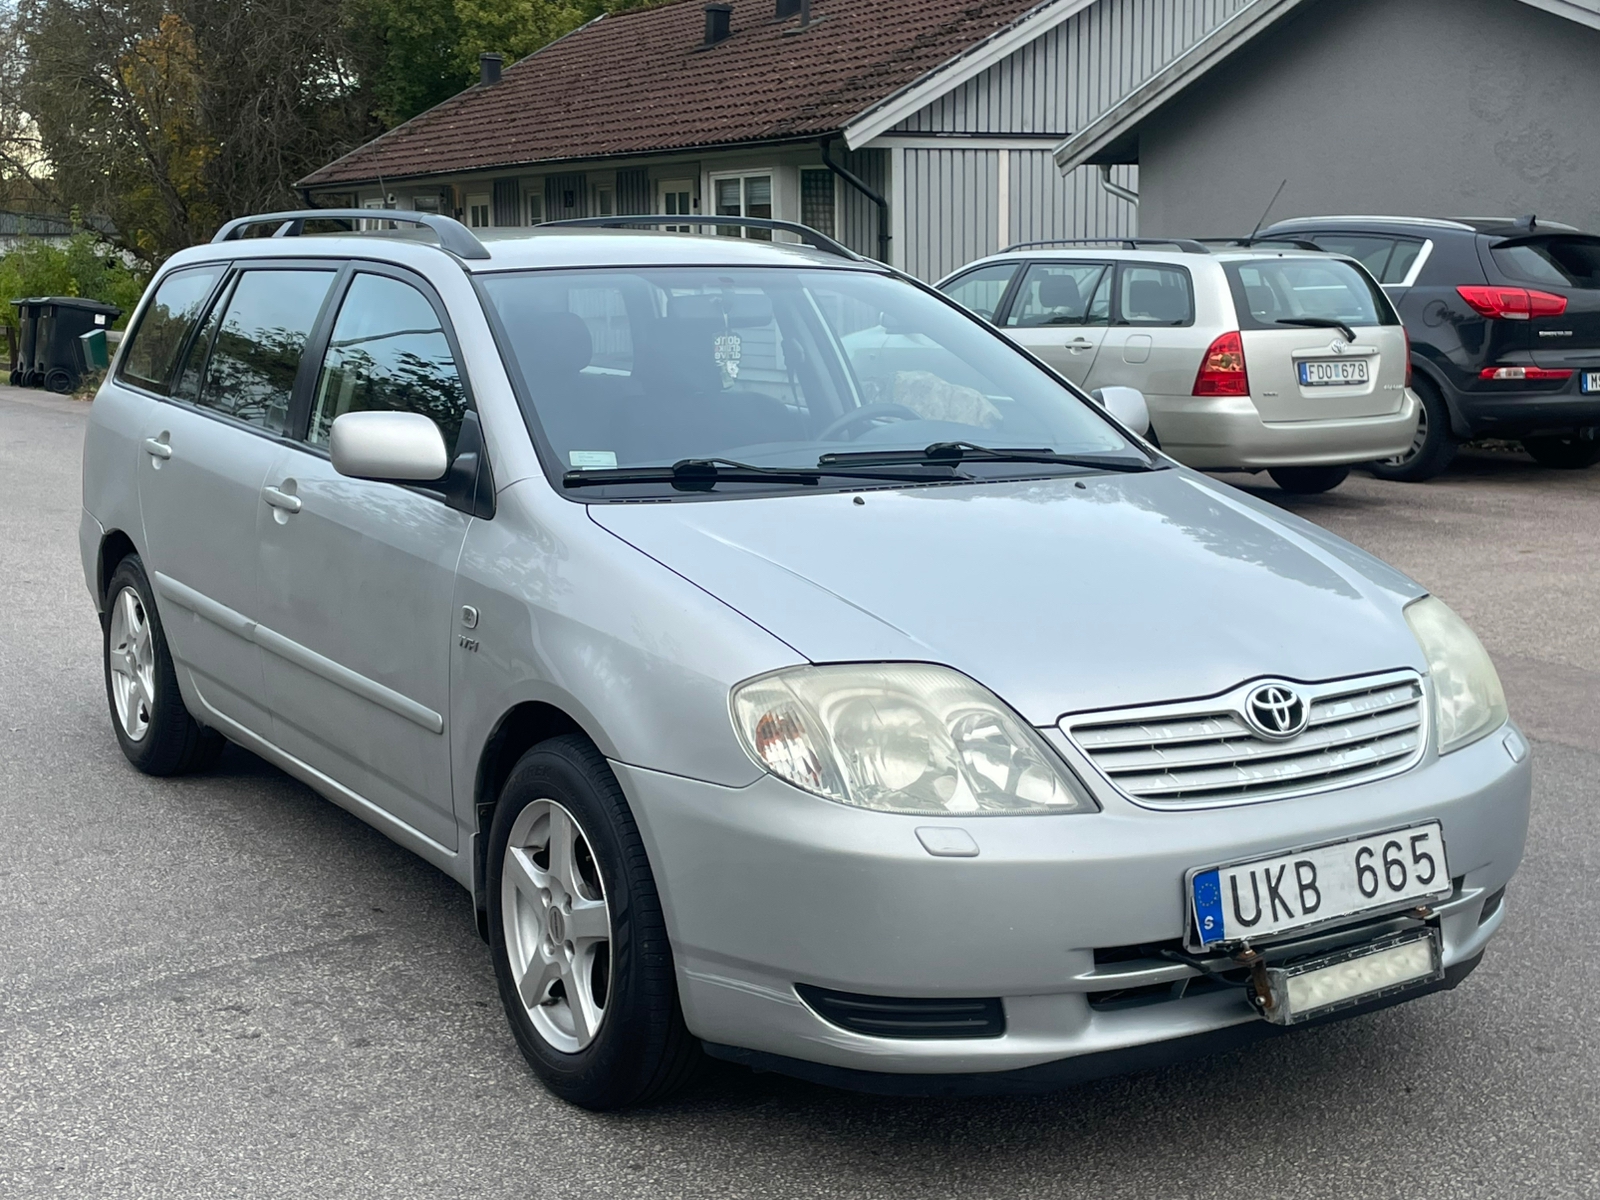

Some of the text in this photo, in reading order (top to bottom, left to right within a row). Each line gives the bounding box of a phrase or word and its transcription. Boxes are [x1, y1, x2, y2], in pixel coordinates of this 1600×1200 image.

[1308, 363, 1365, 380] FDO 678
[1229, 832, 1436, 928] UKB 665
[1204, 915, 1214, 930] S
